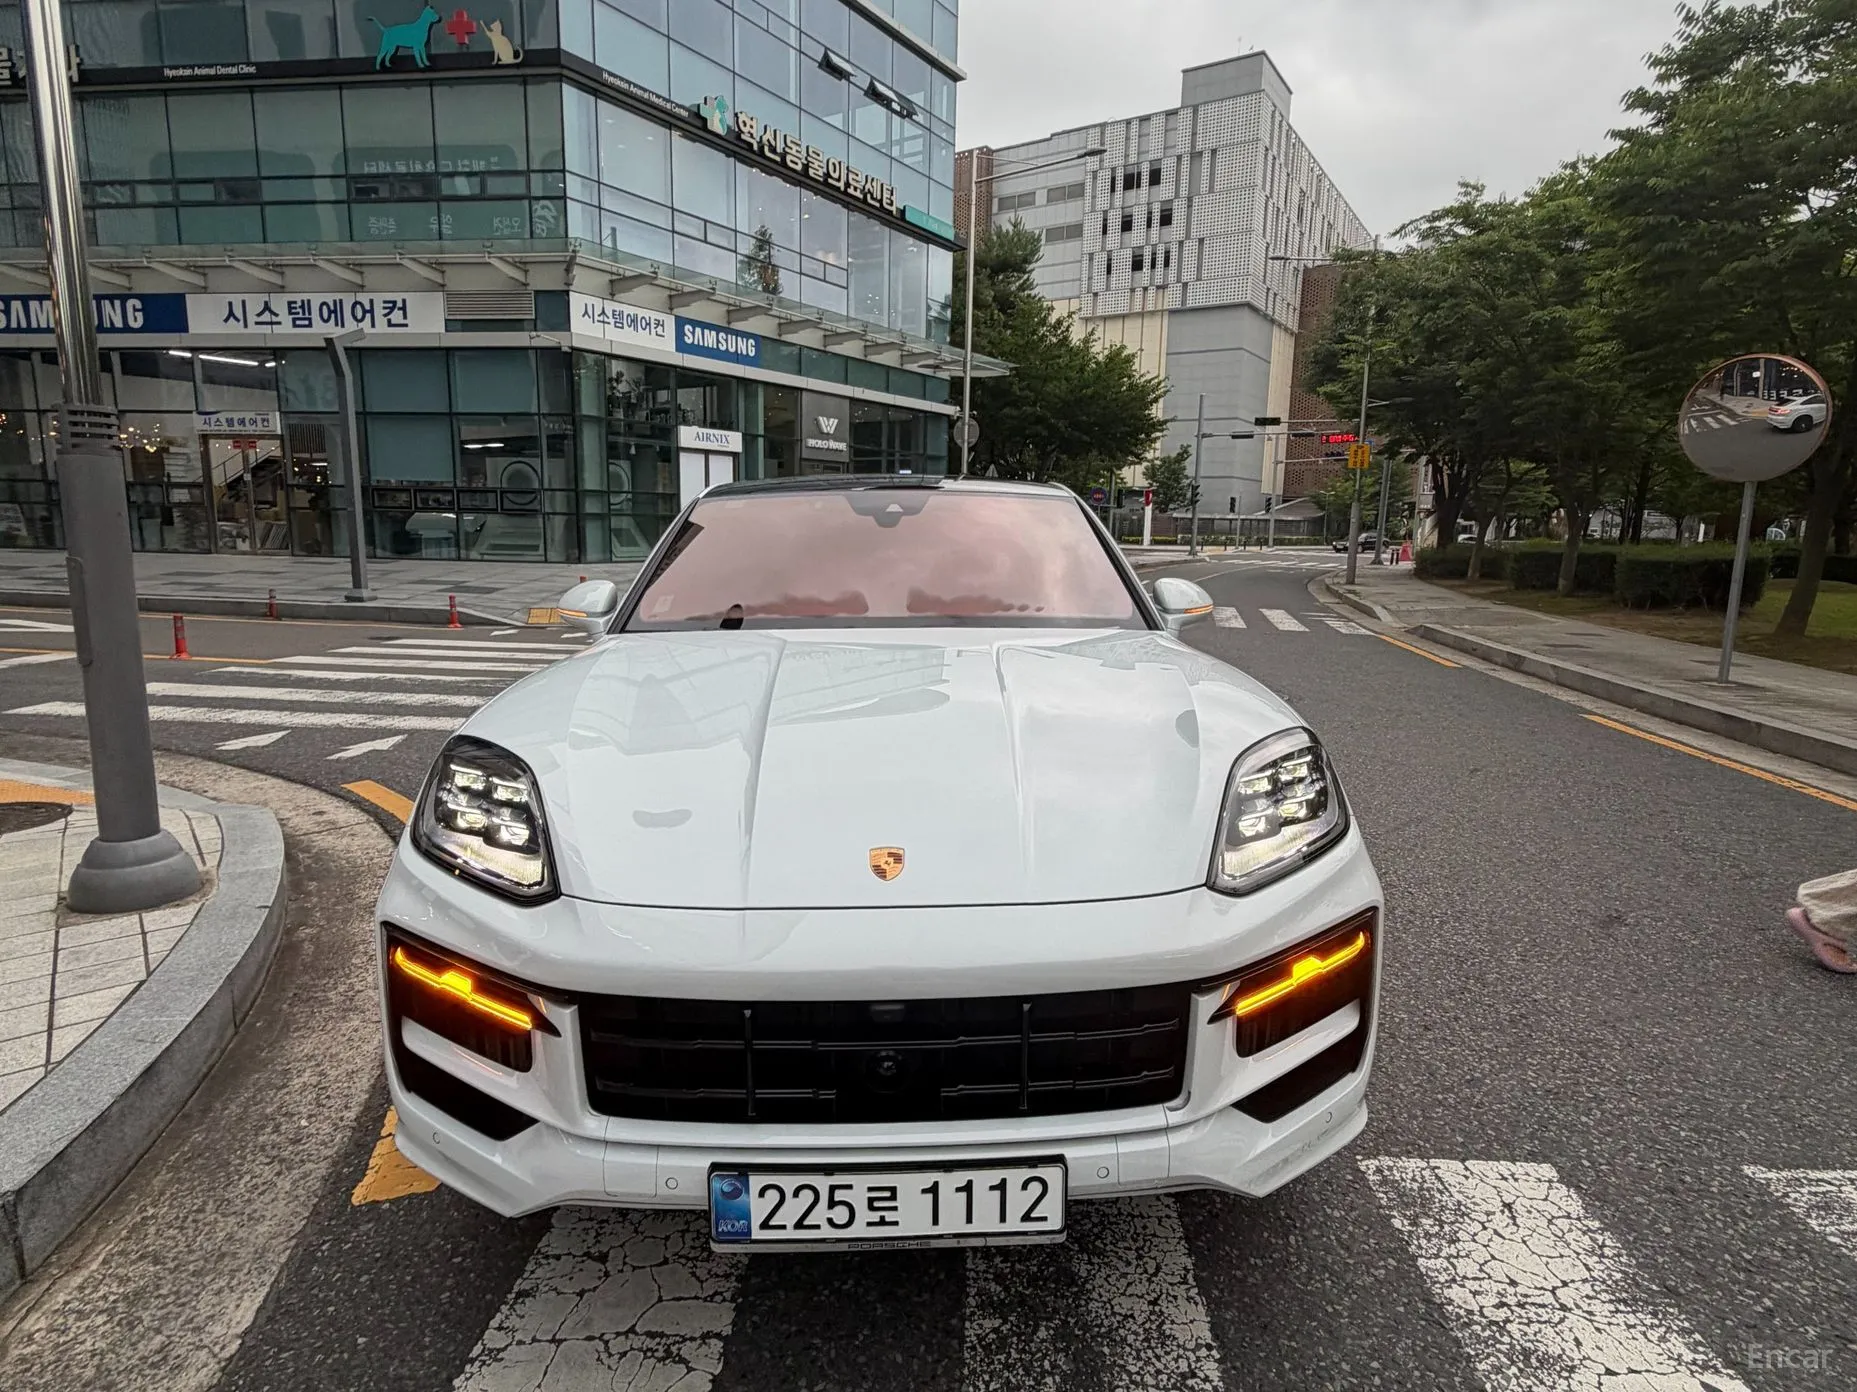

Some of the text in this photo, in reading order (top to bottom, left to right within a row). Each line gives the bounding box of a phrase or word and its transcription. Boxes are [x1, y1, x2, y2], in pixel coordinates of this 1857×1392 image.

[194, 65, 216, 76] Animal
[217, 64, 238, 75] Dental
[239, 63, 257, 74] Clinic
[629, 83, 650, 100] Animal
[649, 92, 672, 110] Medical
[671, 103, 689, 118] Center
[737, 111, 898, 215] 혁신동물의료센터
[0, 297, 145, 330] AMNG
[222, 296, 410, 330] 시스템에어컨
[582, 302, 666, 339] 시스템에어컨
[683, 324, 757, 358] SAMSUNG
[202, 416, 270, 428] 시스템에어컨
[694, 430, 731, 445] AIRNIX
[757, 1175, 1049, 1231] 225로 1112
[718, 1219, 748, 1232] KOR
[847, 1240, 932, 1250] PORSCHE
